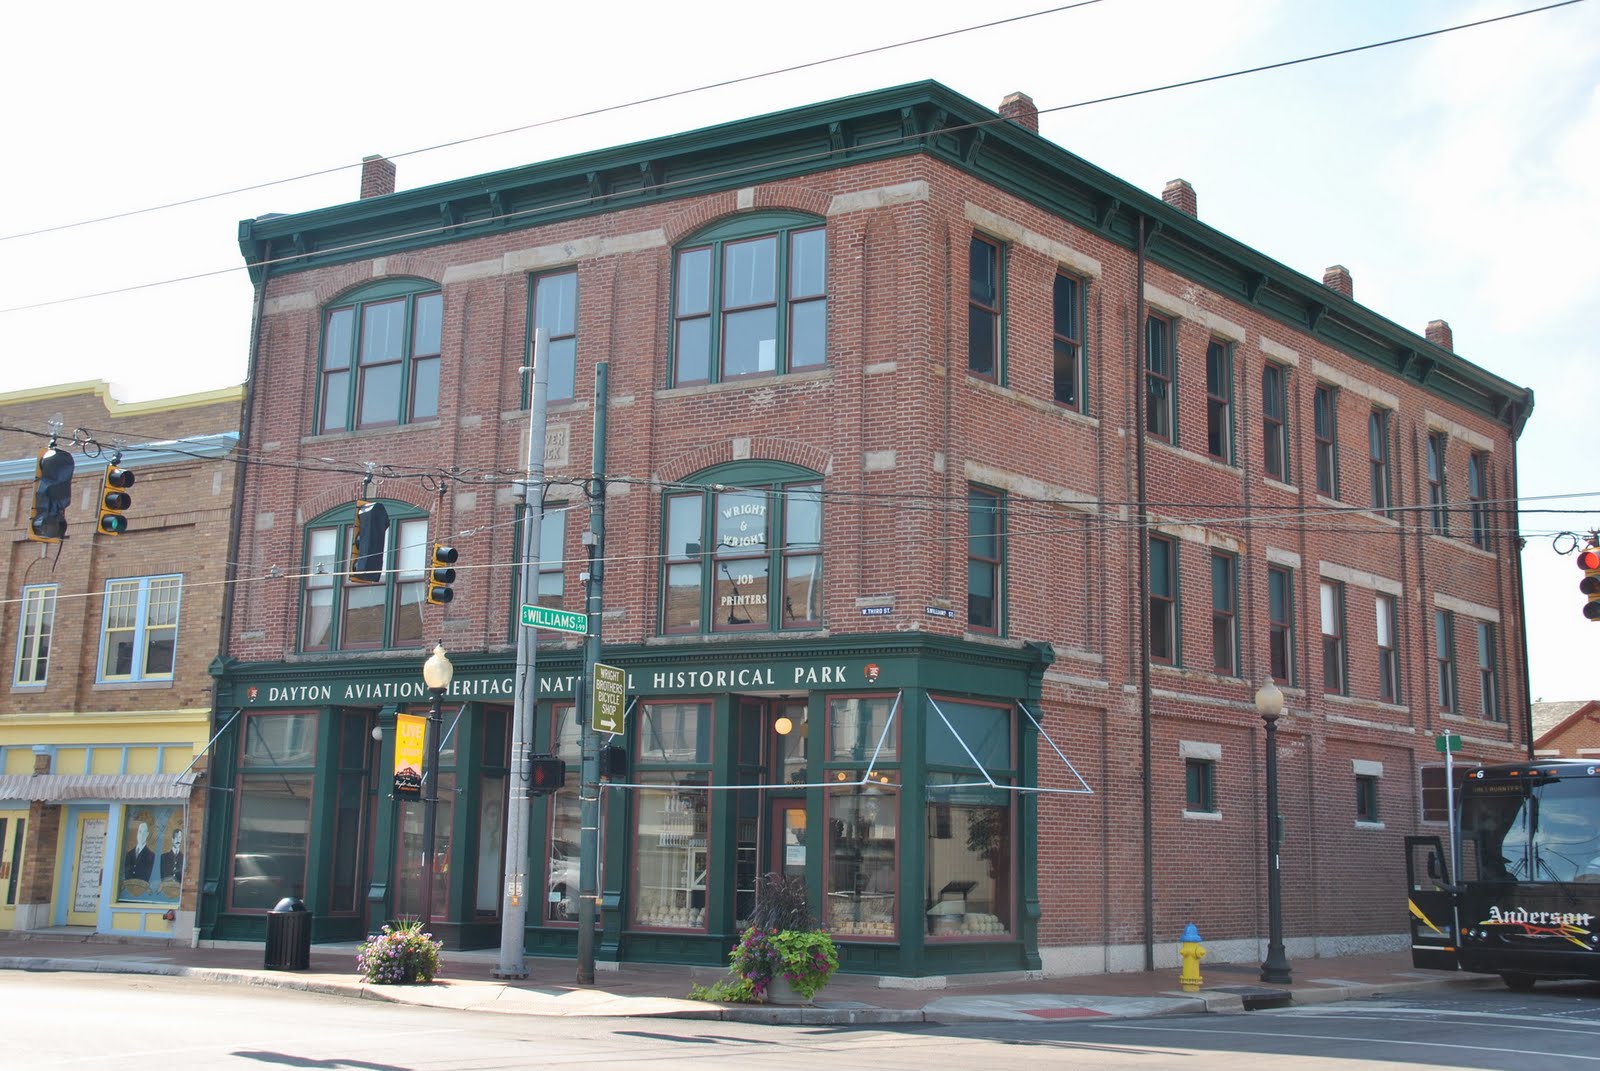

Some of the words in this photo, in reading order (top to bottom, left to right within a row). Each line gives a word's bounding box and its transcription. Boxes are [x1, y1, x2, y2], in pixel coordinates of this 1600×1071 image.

[722, 504, 766, 519] WRIGHT
[740, 521, 748, 531] &
[723, 532, 765, 547] WRIGHT
[736, 574, 754, 585] JOB
[721, 594, 767, 606] PRINTERS
[528, 609, 576, 629] WILLIAMS
[577, 616, 584, 624] ST
[600, 668, 620, 682] WRIGHT
[269, 685, 331, 702] DAYTON
[344, 681, 425, 699] AVIATION
[446, 678, 513, 696] ERITAG
[653, 668, 775, 688] HISTORICAL
[794, 666, 847, 684] PARK
[596, 679, 623, 695] BROTHERS
[598, 691, 620, 706] BICYCLE
[602, 703, 617, 716] SHOP
[401, 722, 423, 739] LIVE
[1476, 770, 1484, 779] 6
[1587, 766, 1596, 775] 6
[1488, 905, 1595, 926] Anderson
